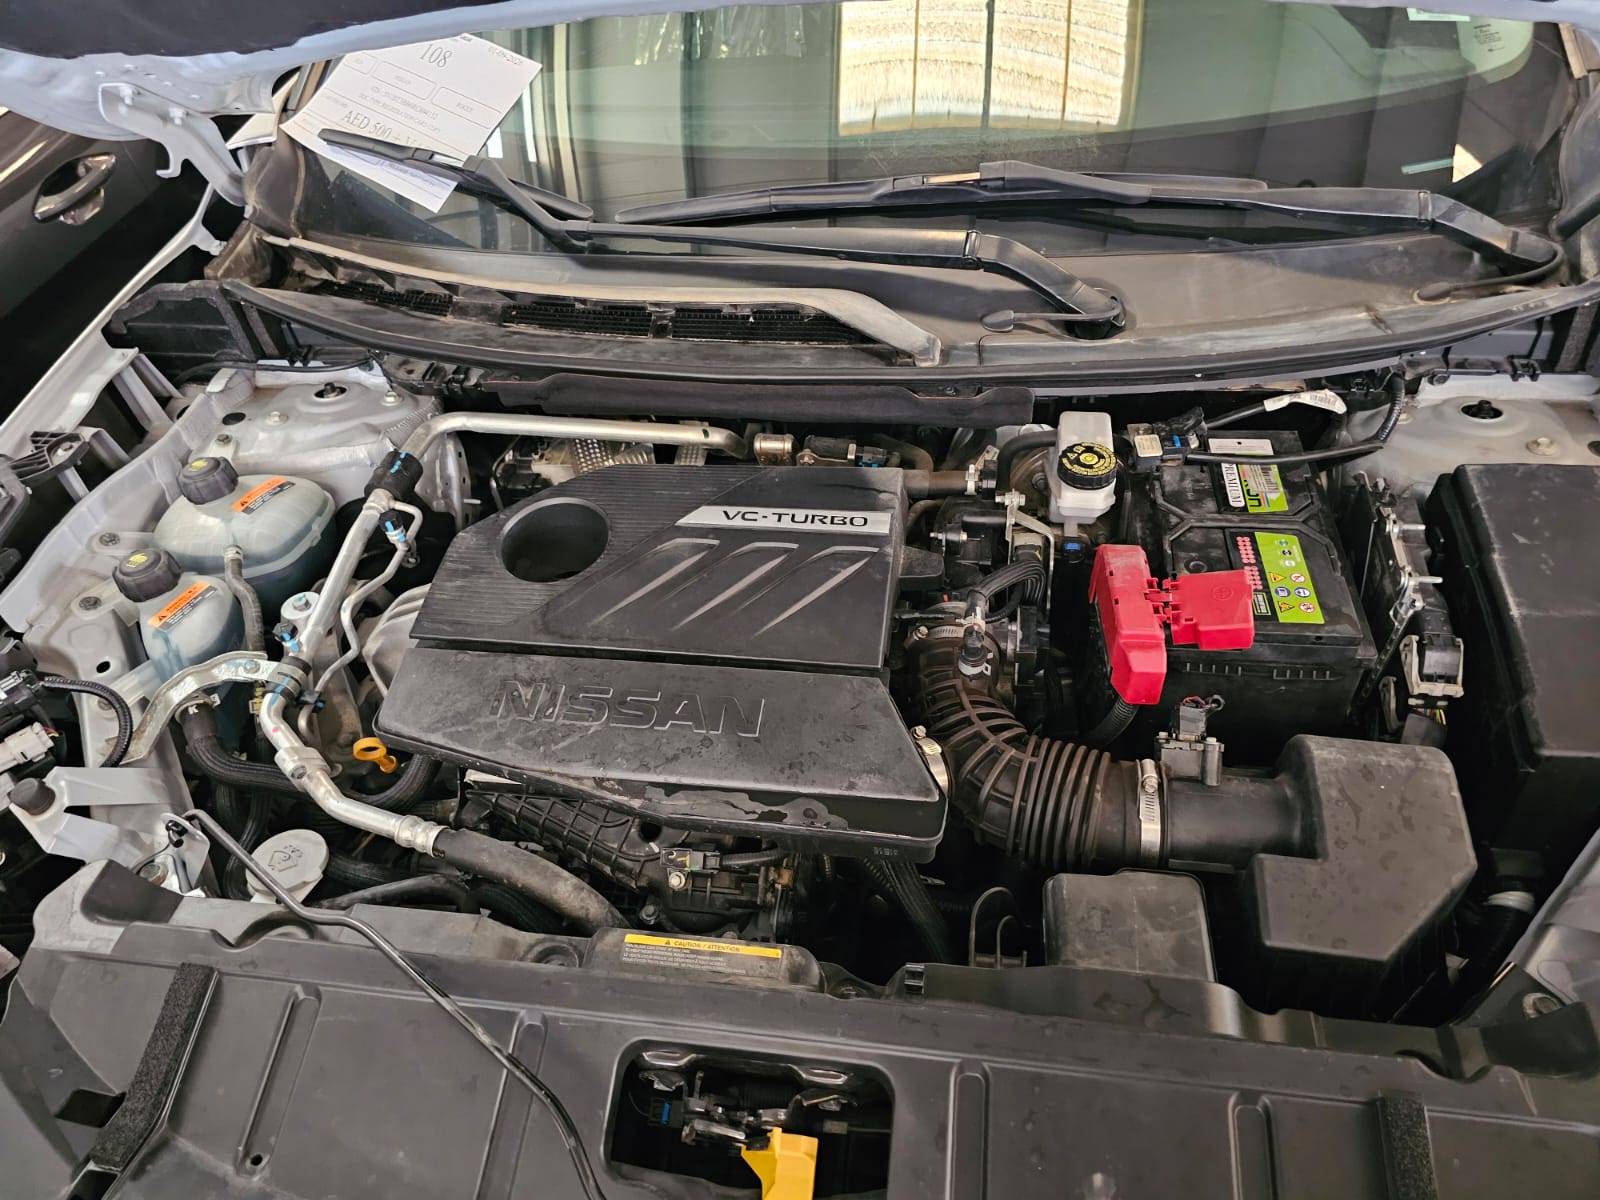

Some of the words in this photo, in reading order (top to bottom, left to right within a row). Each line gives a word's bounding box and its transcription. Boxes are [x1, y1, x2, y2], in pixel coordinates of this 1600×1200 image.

[420, 44, 452, 69] 108
[341, 110, 371, 130] AED
[722, 509, 869, 527] VC-TURBO
[490, 679, 766, 738] NISSAN
